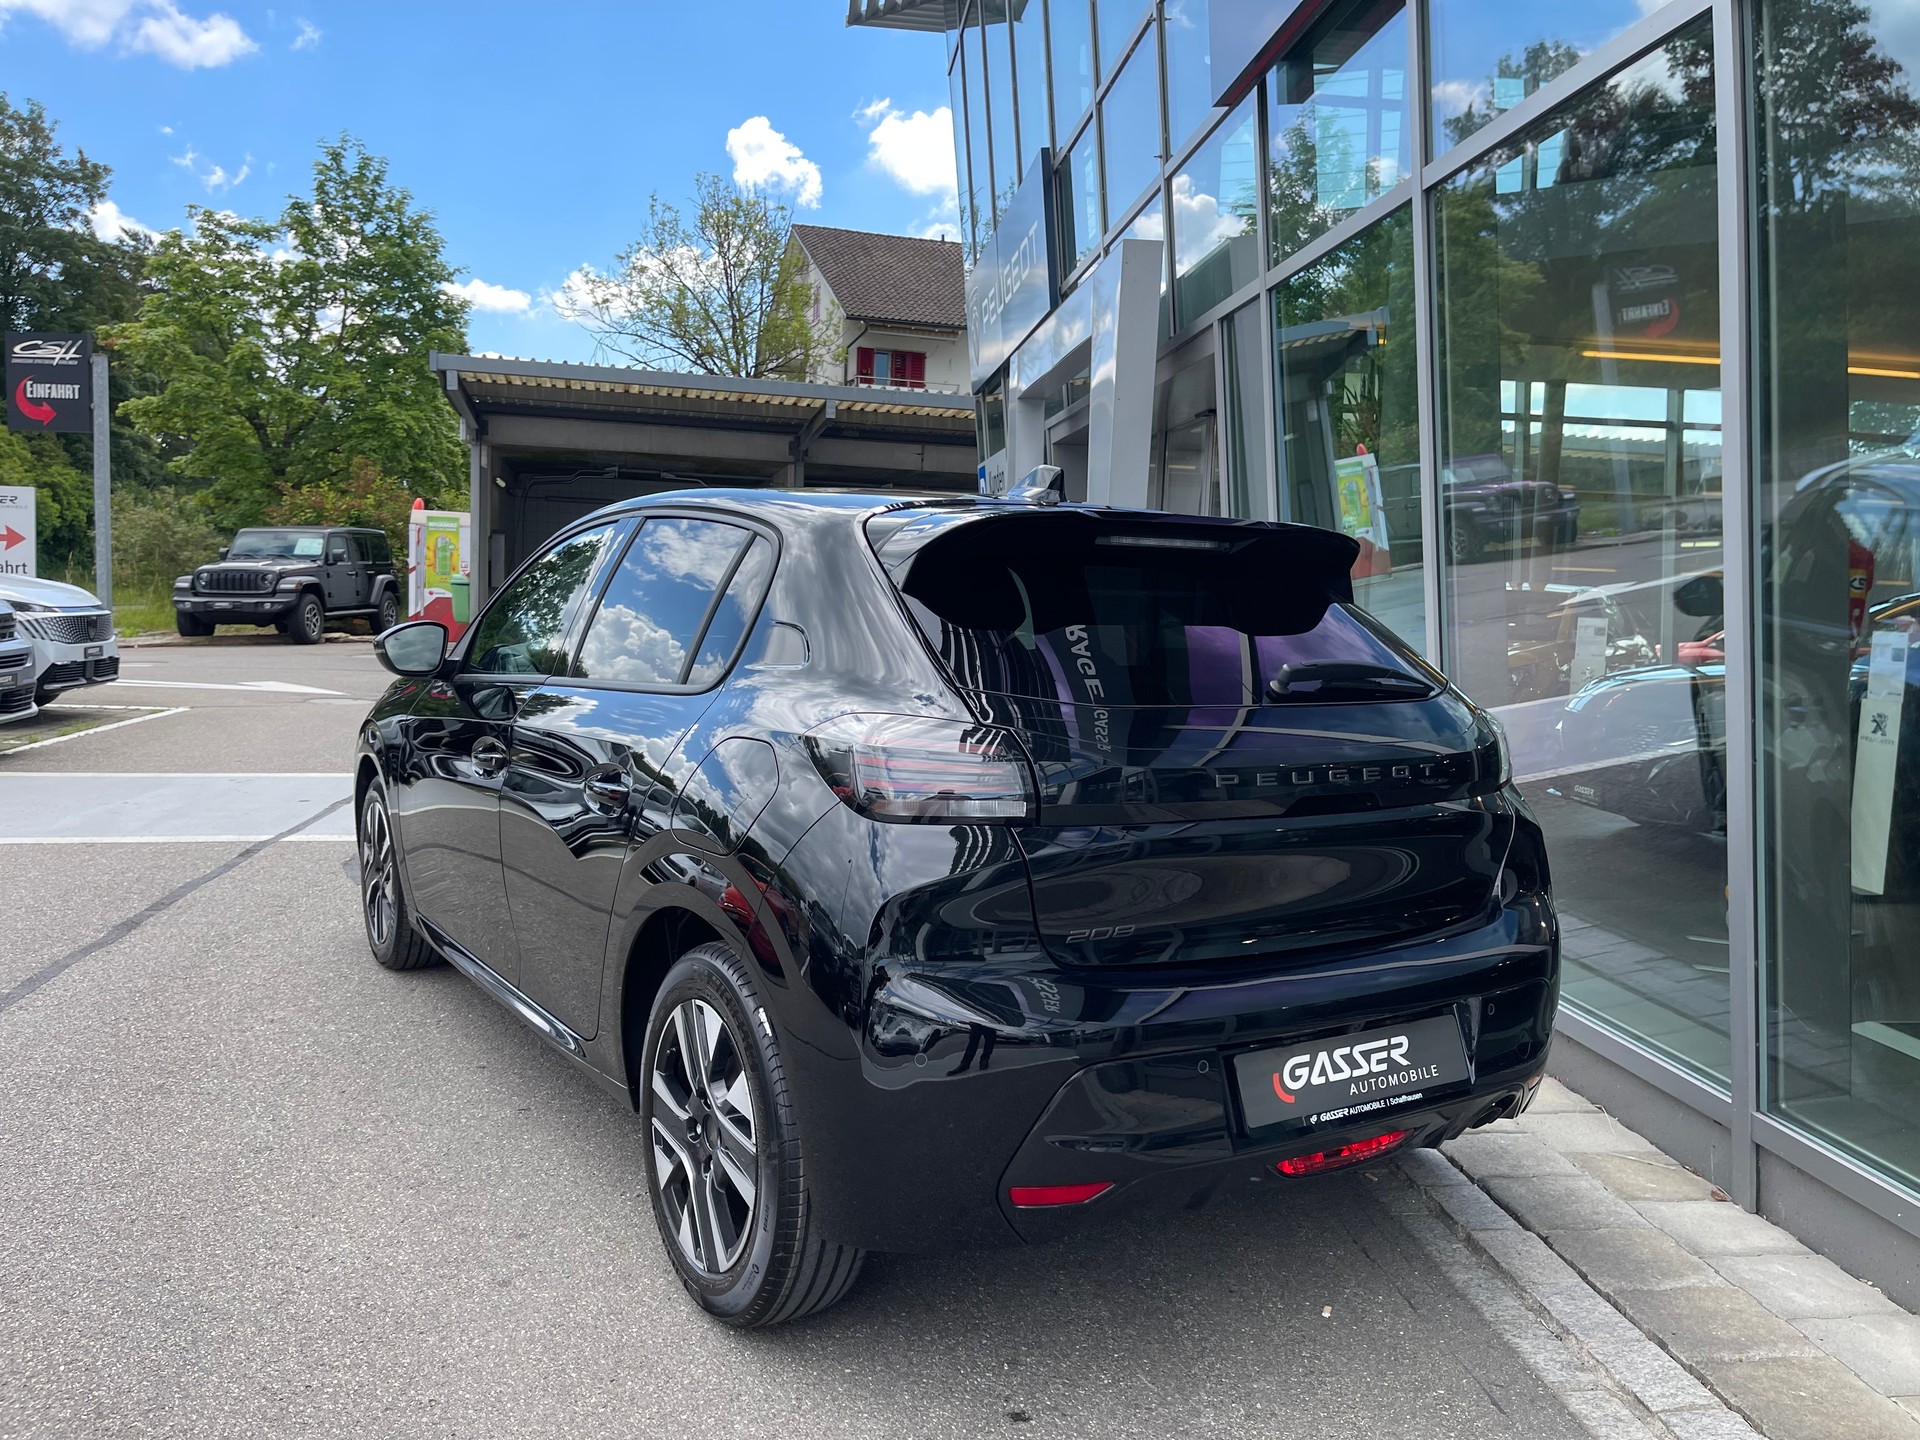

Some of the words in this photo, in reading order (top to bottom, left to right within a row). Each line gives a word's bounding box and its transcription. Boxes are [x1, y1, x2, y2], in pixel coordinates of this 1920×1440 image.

[982, 219, 1038, 334] PEUGEOT
[1215, 763, 1435, 788] PEUGEOT
[1066, 924, 1135, 944] 208
[1282, 1035, 1412, 1091] GASSER
[1349, 1064, 1440, 1096] AUTOMOBILE
[1320, 1108, 1350, 1122] GASSER
[1349, 1099, 1386, 1115] AUTOMOBILE
[1390, 1092, 1423, 1106] Schaffhausen
